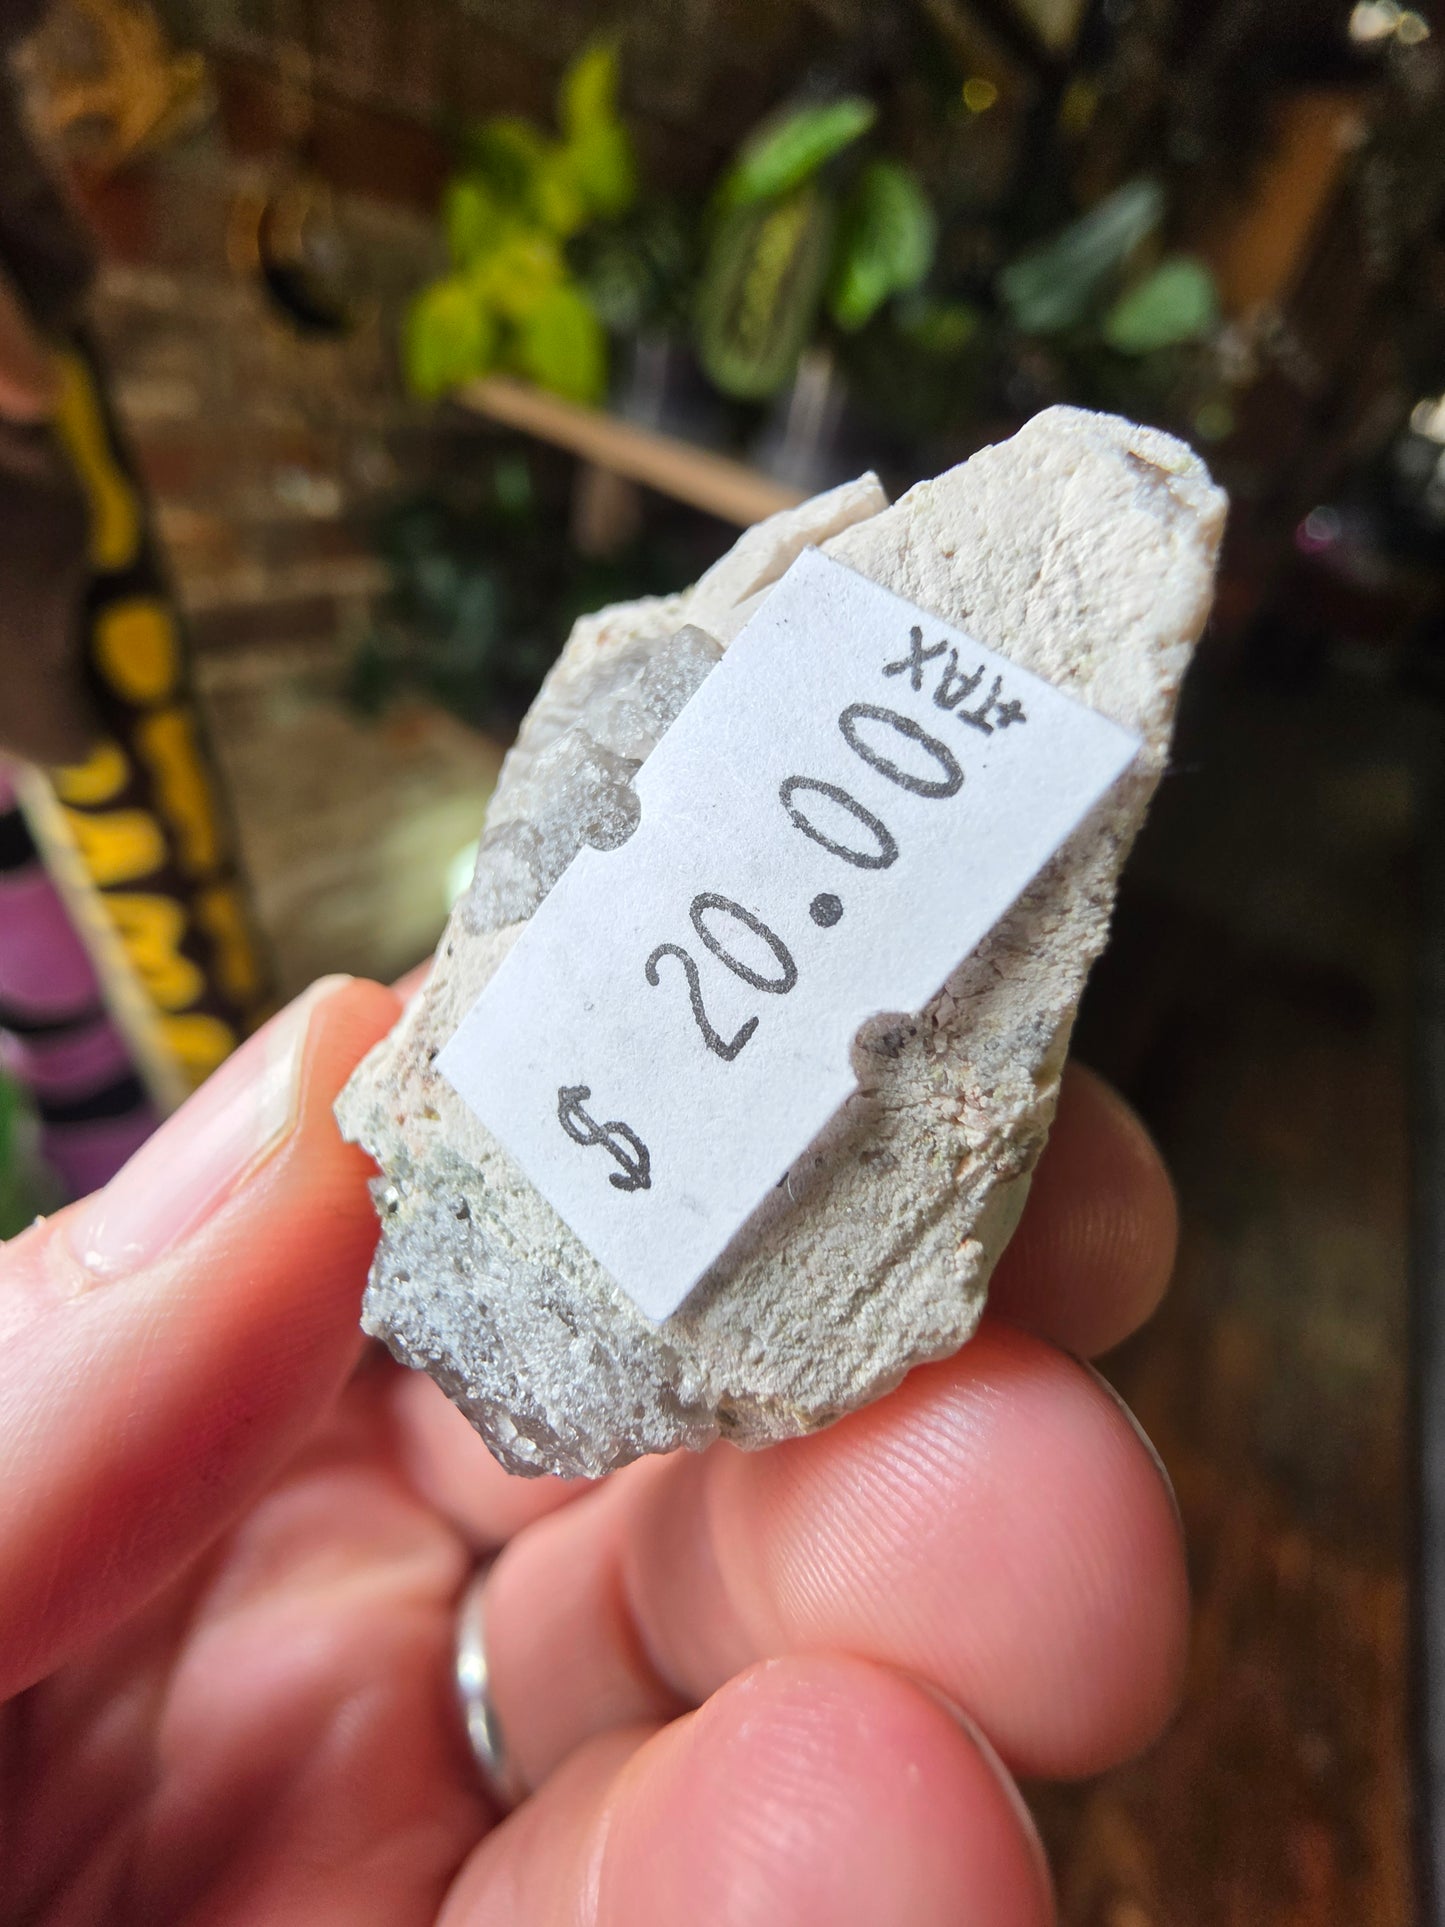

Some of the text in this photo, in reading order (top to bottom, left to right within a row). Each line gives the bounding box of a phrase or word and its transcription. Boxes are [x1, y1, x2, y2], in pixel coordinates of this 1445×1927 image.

[881, 626, 1026, 736] +TAX
[557, 703, 964, 1192] $ 20.00
